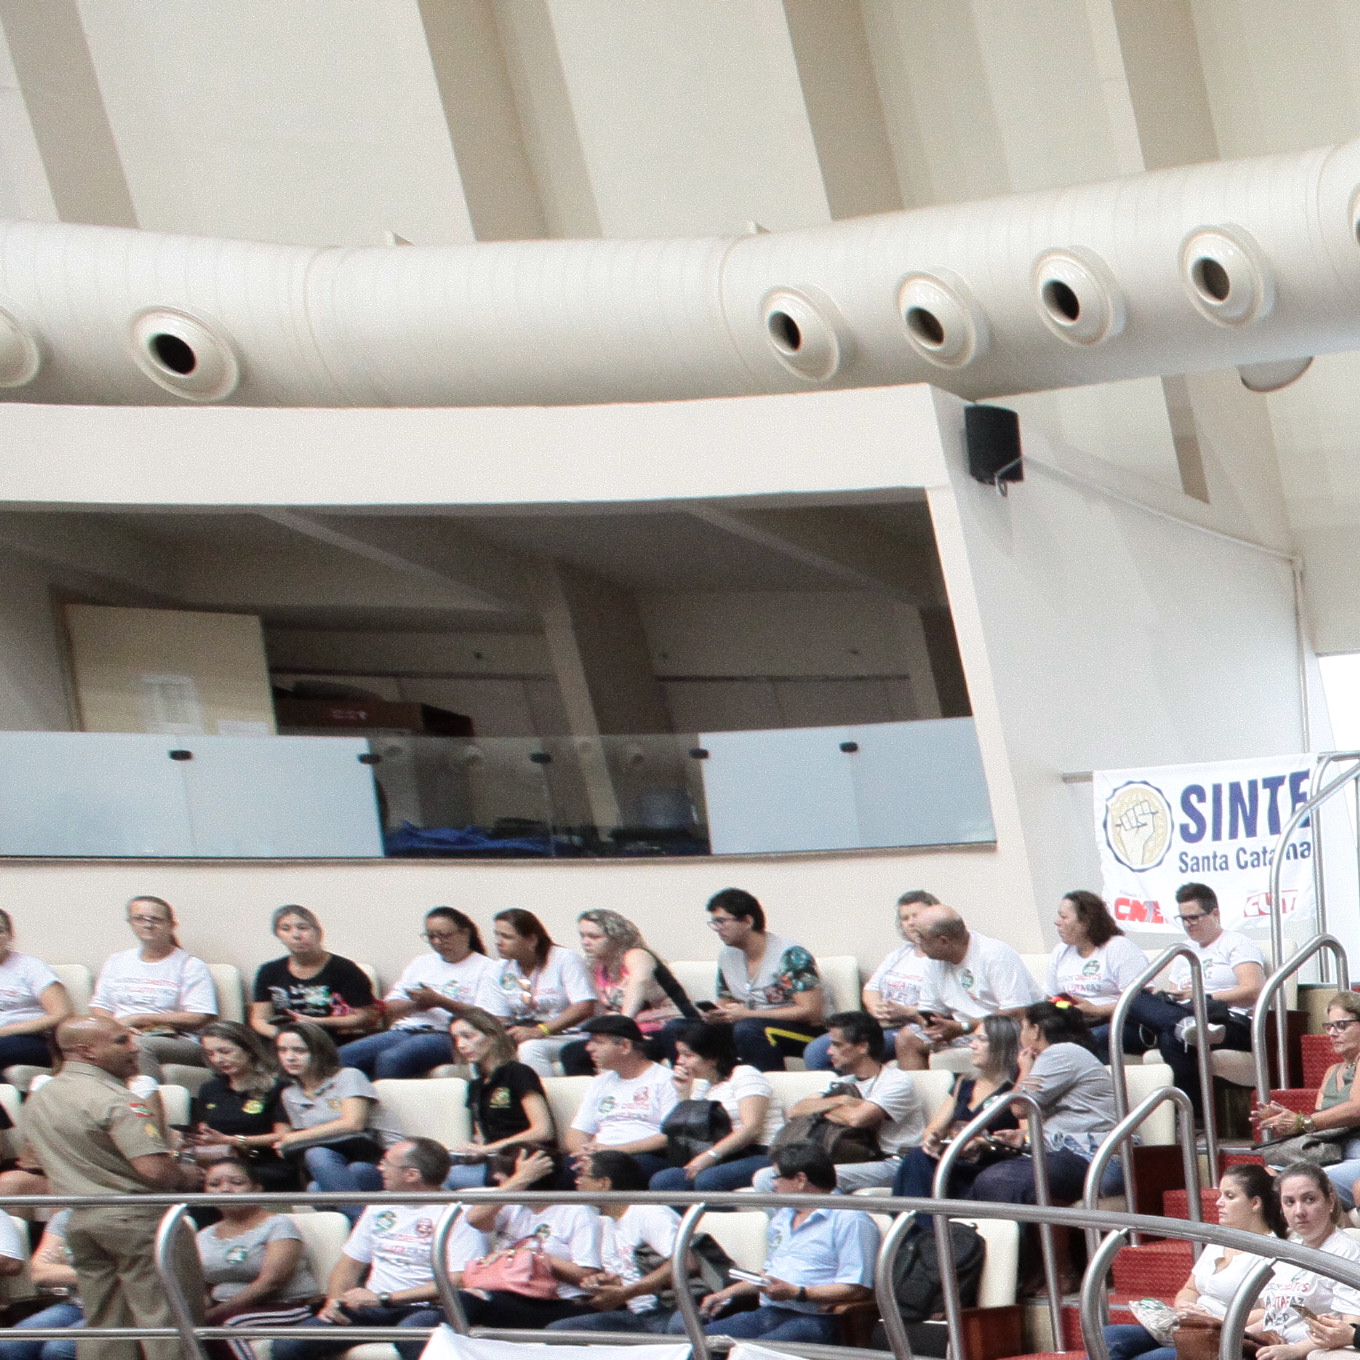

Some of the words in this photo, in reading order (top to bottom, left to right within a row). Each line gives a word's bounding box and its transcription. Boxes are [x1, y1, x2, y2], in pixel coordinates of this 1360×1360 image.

[1179, 768, 1311, 844] SINTE
[1178, 851, 1229, 873] Santa
[1236, 840, 1312, 870] Catna
